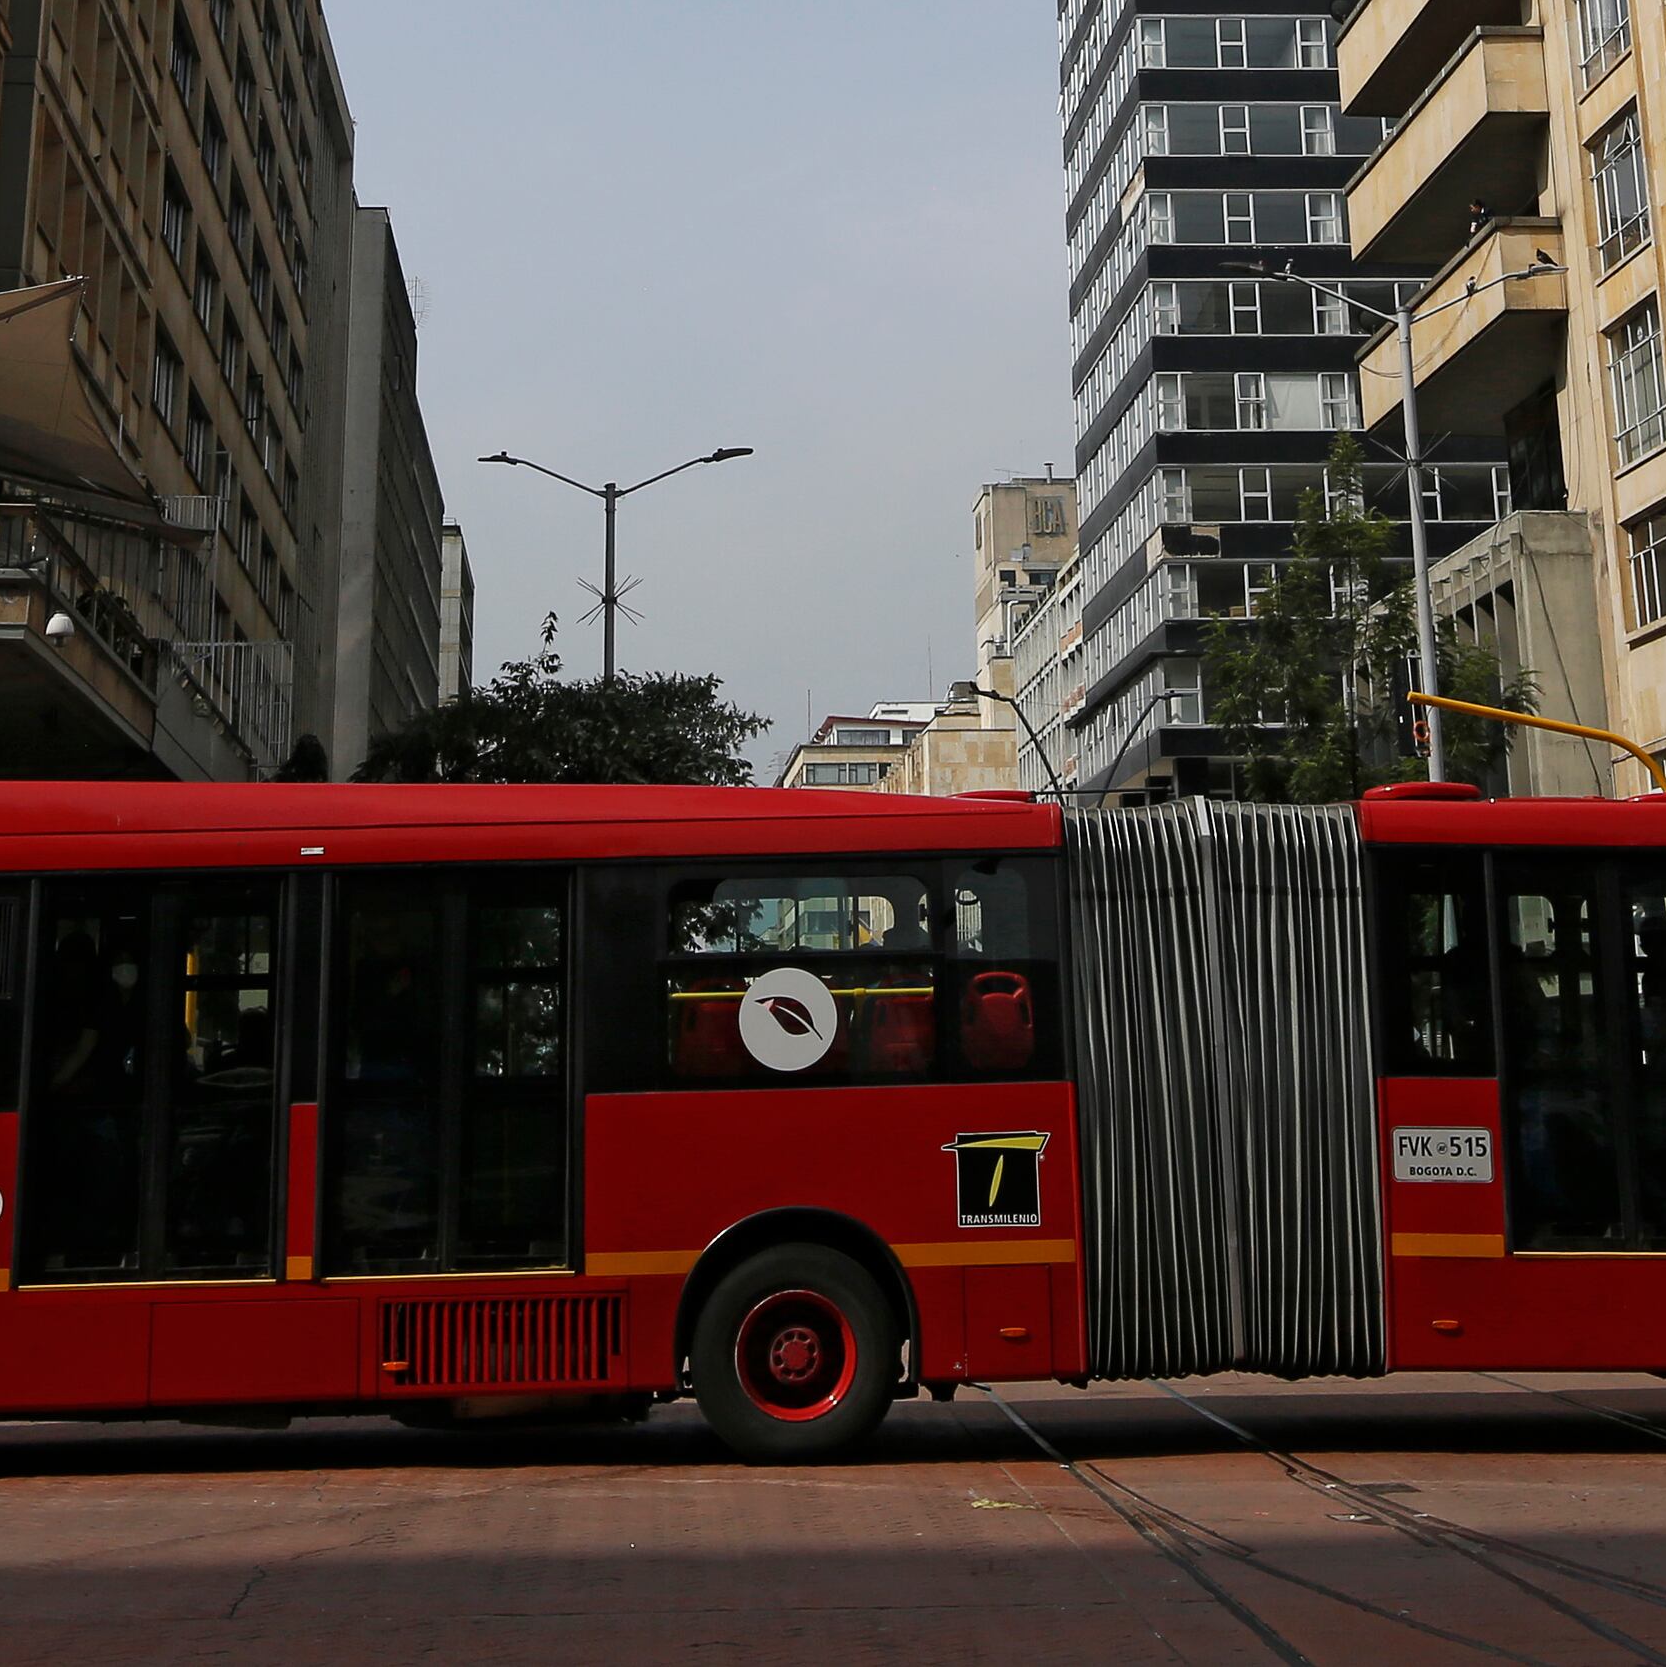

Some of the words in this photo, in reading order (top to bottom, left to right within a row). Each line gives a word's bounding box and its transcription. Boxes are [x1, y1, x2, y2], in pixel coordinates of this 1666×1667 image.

[1398, 1136, 1433, 1157] FVK
[1449, 1136, 1488, 1157] 515
[1409, 1166, 1453, 1177] BOGOTA
[1456, 1167, 1478, 1177] D.C.
[961, 1213, 1038, 1225] TRANSMILENIO
